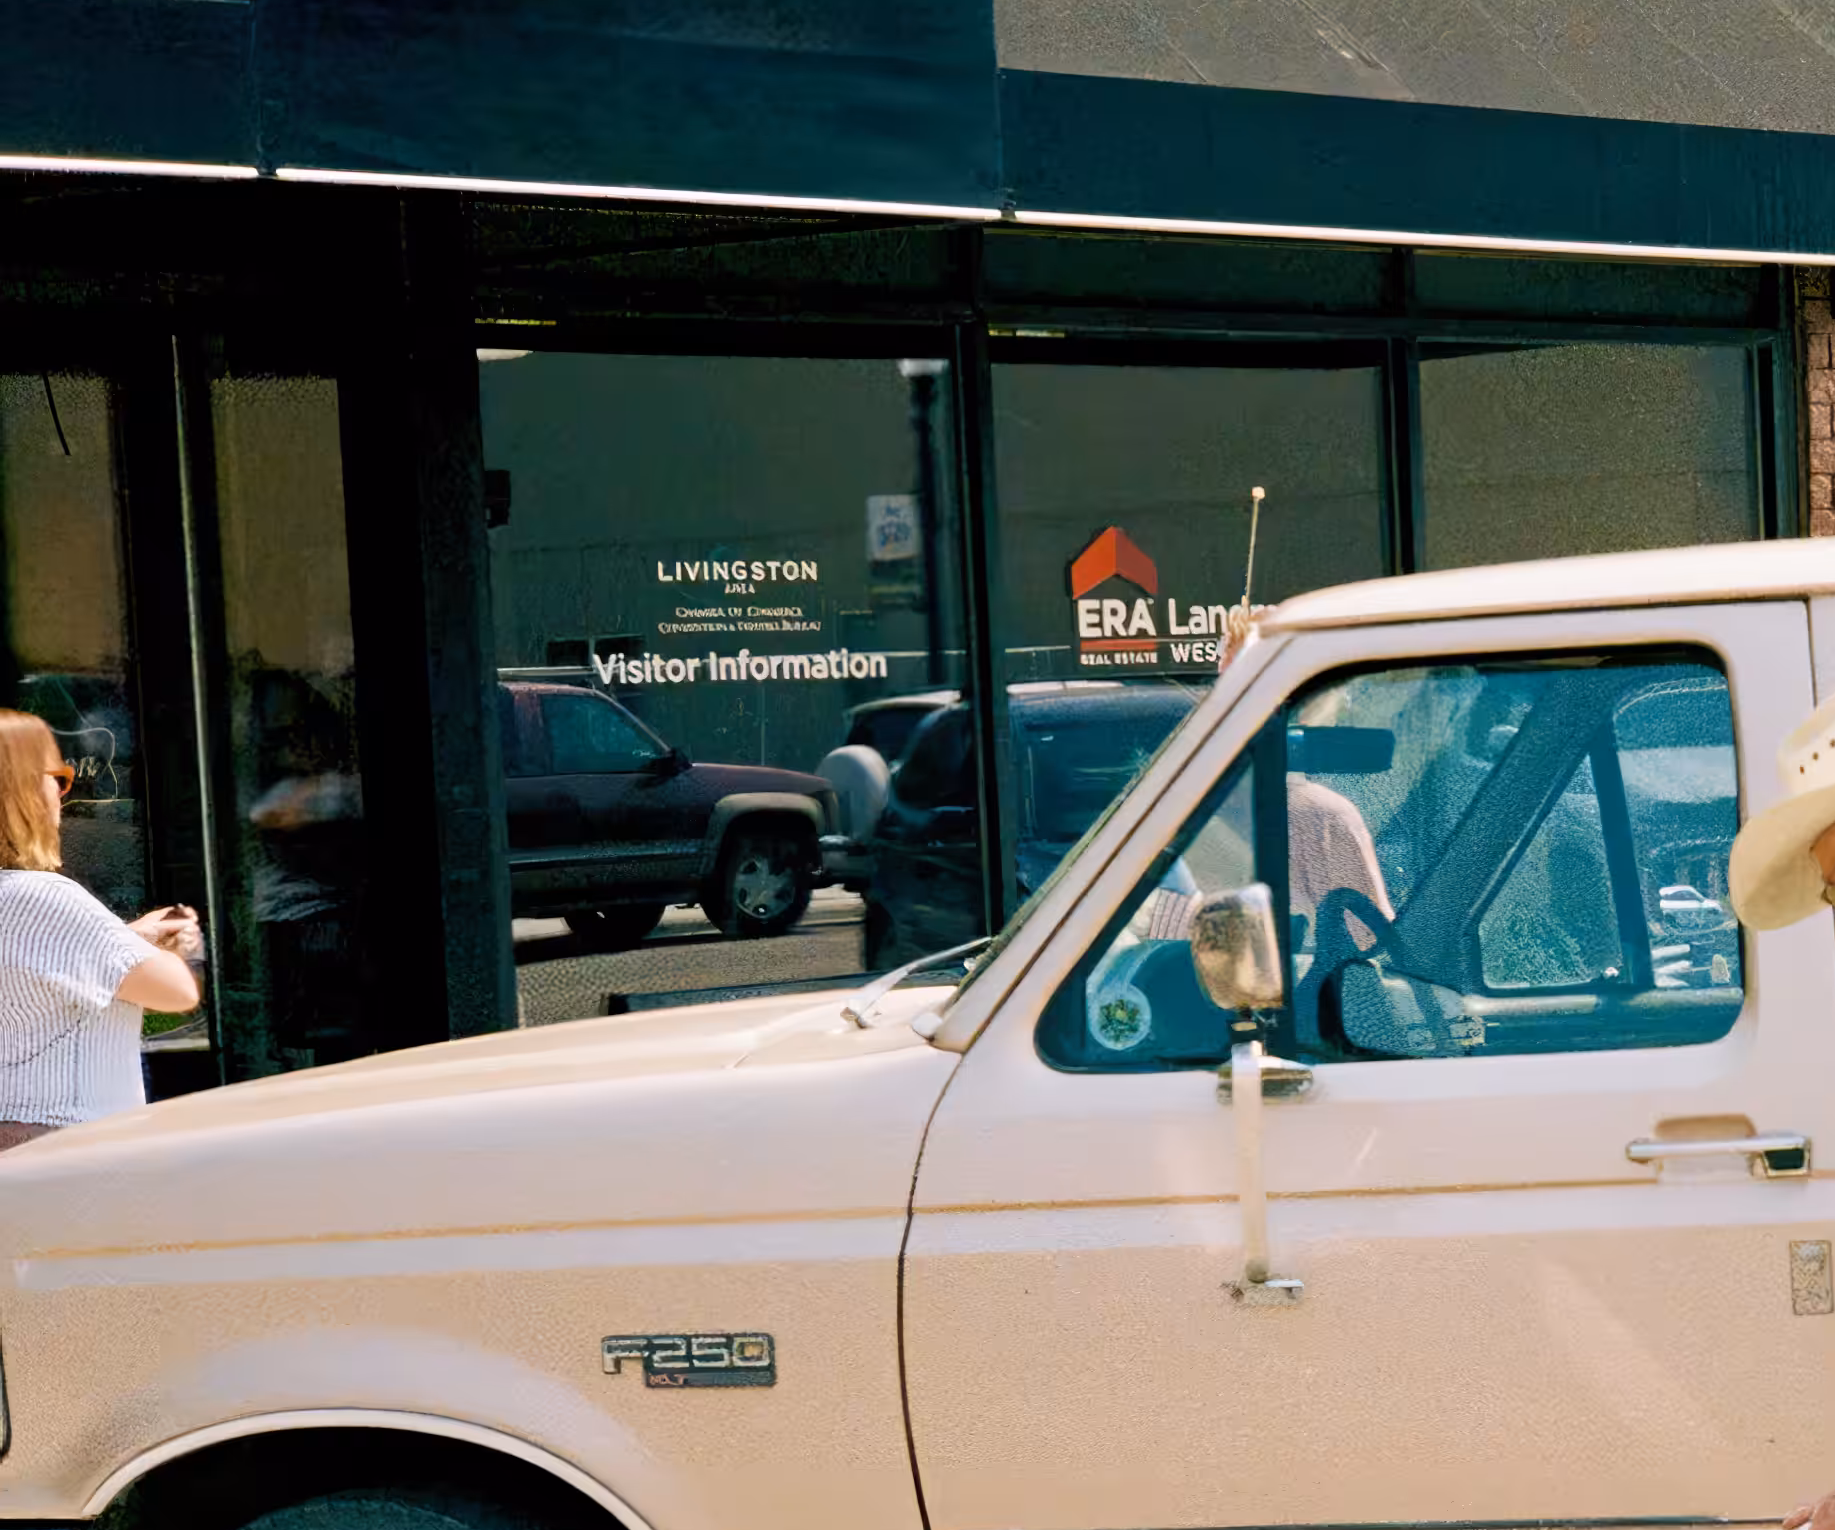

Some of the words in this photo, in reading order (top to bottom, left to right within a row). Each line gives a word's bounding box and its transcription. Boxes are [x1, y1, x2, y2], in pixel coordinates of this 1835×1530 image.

[657, 560, 818, 582] LIVINGSTON
[1077, 598, 1157, 637] ERA
[593, 652, 702, 685] Visitor
[709, 648, 888, 681] Information
[1170, 642, 1222, 663] WES
